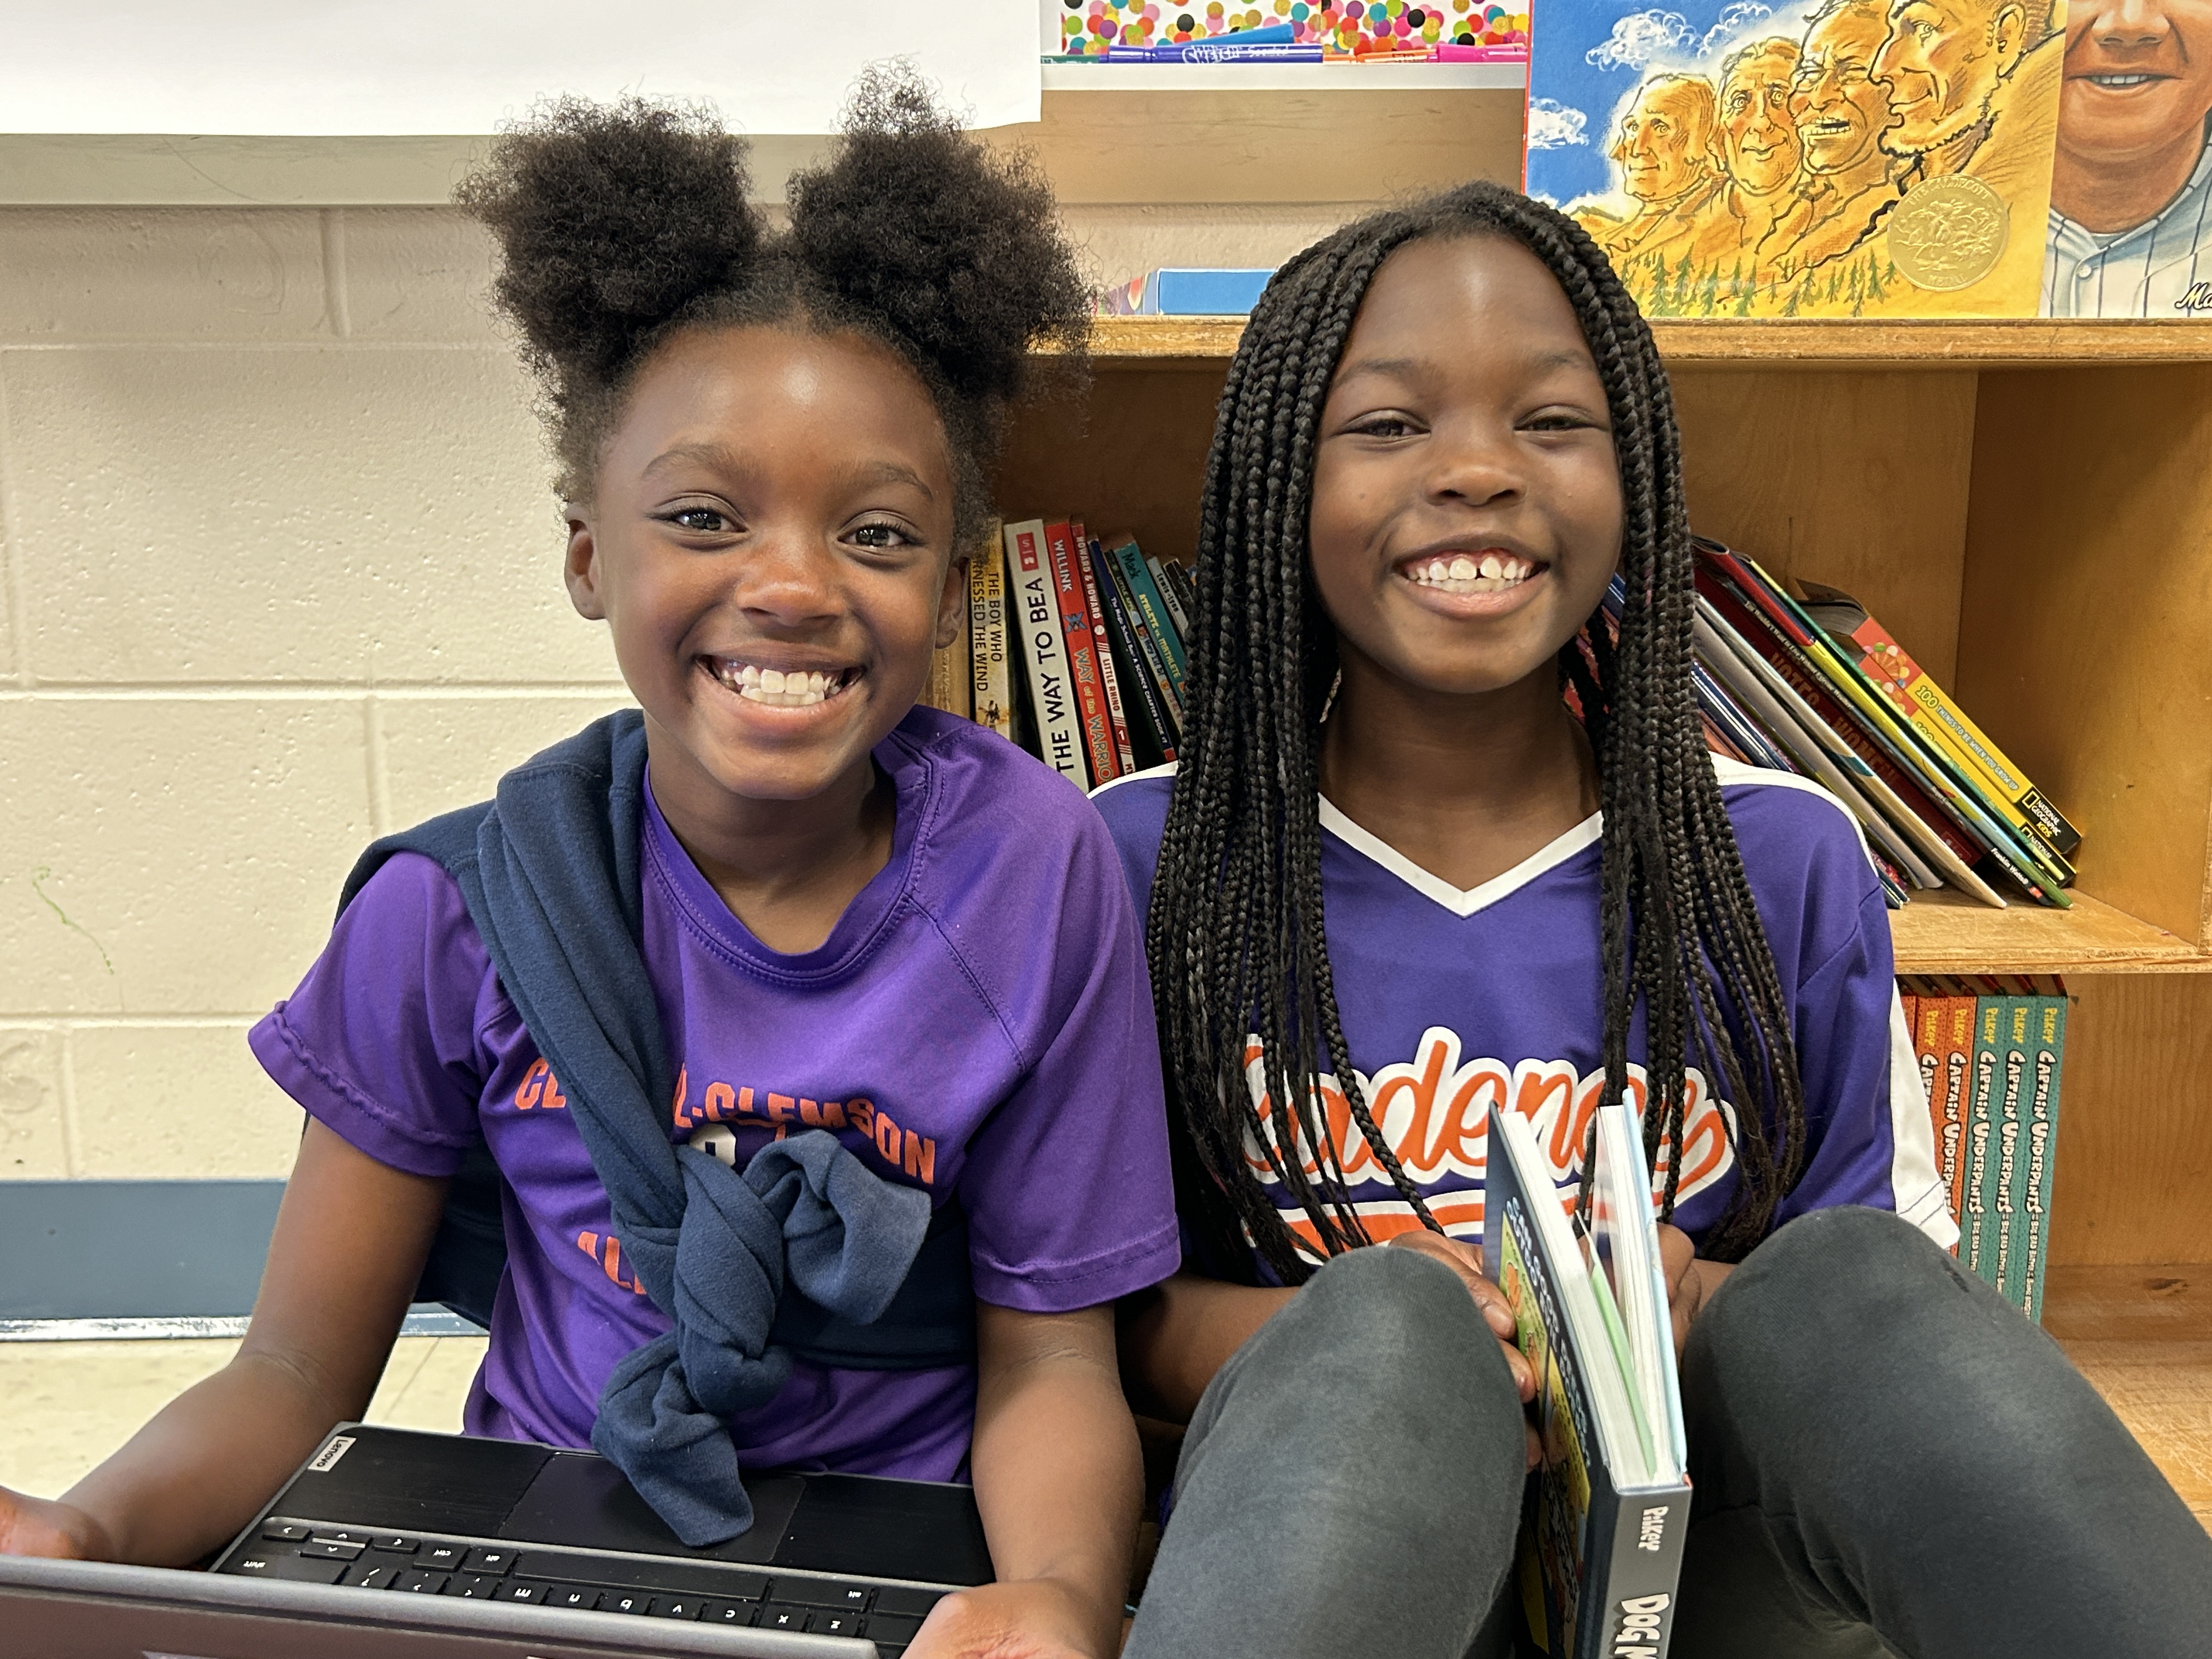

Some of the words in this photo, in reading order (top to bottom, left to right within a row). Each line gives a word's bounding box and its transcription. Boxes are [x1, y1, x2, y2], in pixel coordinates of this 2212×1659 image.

[1054, 539, 1073, 592] WILLINK
[1076, 537, 1091, 572] HOWARD
[1086, 583, 1101, 619] HOWARD
[988, 572, 1000, 596] THE
[989, 600, 1001, 627] BOY
[974, 625, 986, 649] THE
[990, 630, 1002, 662] WHO
[1035, 631, 1056, 665] TO
[975, 652, 988, 692] WIND
[1074, 647, 1096, 684] WAY
[1103, 658, 1115, 684] LITTLE
[1040, 673, 1065, 723] WAY
[1086, 699, 1096, 714] the
[1108, 686, 1120, 711] RHINO
[1051, 730, 1075, 773] THE
[1087, 714, 1115, 784] WARRIO
[1118, 730, 1125, 741] 1
[1915, 685, 1939, 708] 100
[1936, 704, 1958, 729] THINGS
[1955, 724, 1966, 736] TO
[1961, 732, 1972, 744] BE
[1968, 740, 1988, 759] WHEN
[1984, 755, 1998, 770] YOU
[1994, 766, 2012, 786] GROW
[2008, 780, 2019, 791] UP
[2031, 805, 2061, 837] GEOGRAPHIC
[2036, 800, 2060, 826] NATIONAL
[1968, 1122, 1990, 1214] UNDERPANTS
[1997, 1121, 2019, 1213] UNDERPANTS
[2027, 1121, 2049, 1213] UNDERPANTS
[317, 1439, 348, 1467] Lenovo
[1615, 1593, 1671, 1643] DOG
